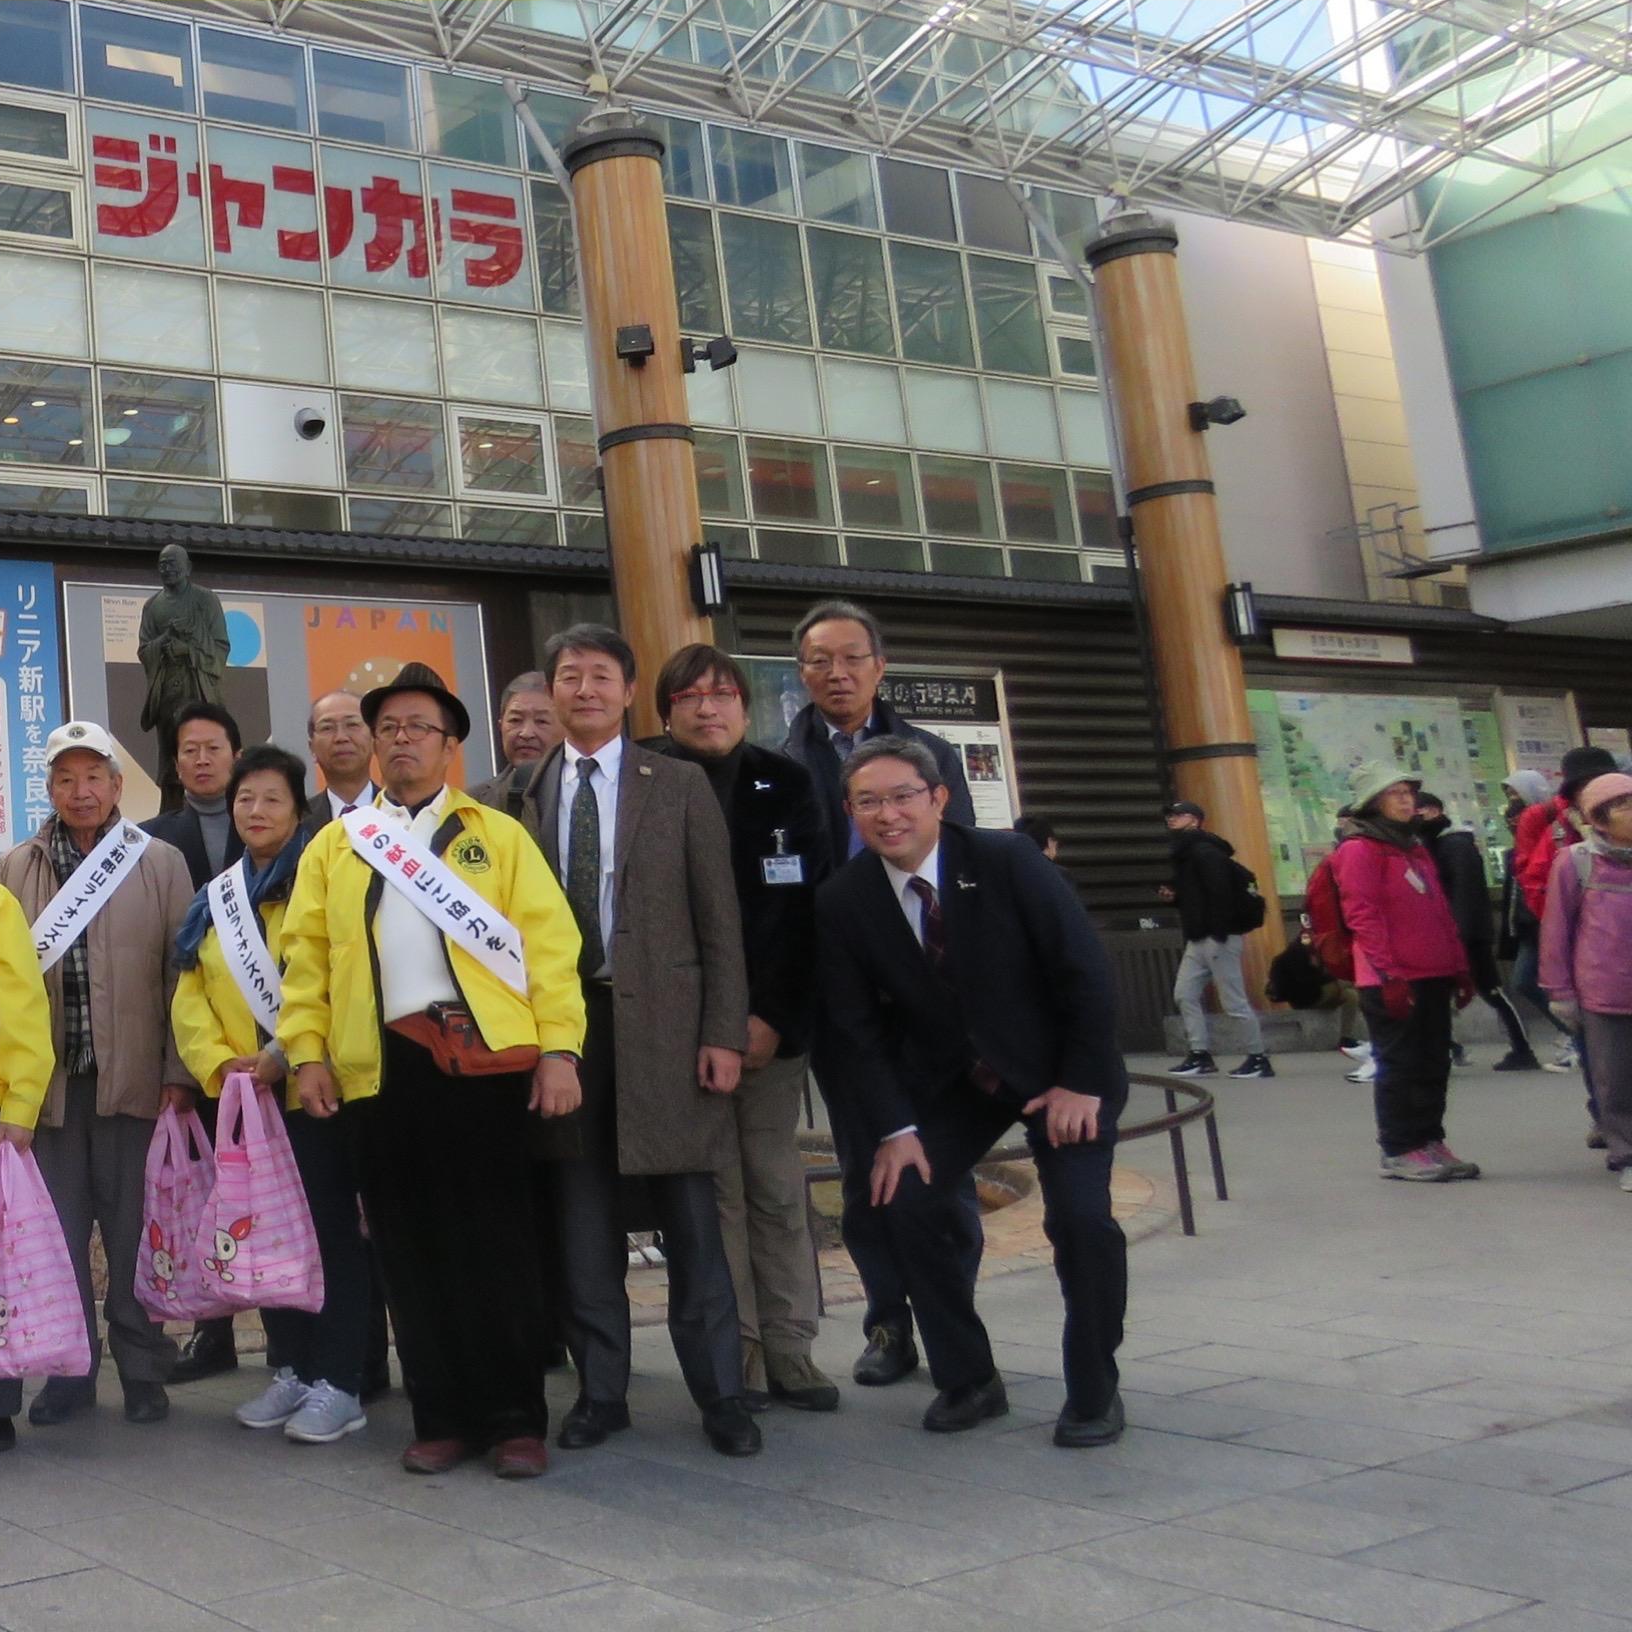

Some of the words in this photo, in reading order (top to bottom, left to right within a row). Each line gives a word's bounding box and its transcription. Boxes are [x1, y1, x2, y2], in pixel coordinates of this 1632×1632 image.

[91, 133, 525, 290] ジャンカラ
[307, 606, 450, 634] JAPAN
[36, 840, 132, 960] 大和郡山ライオンズク
